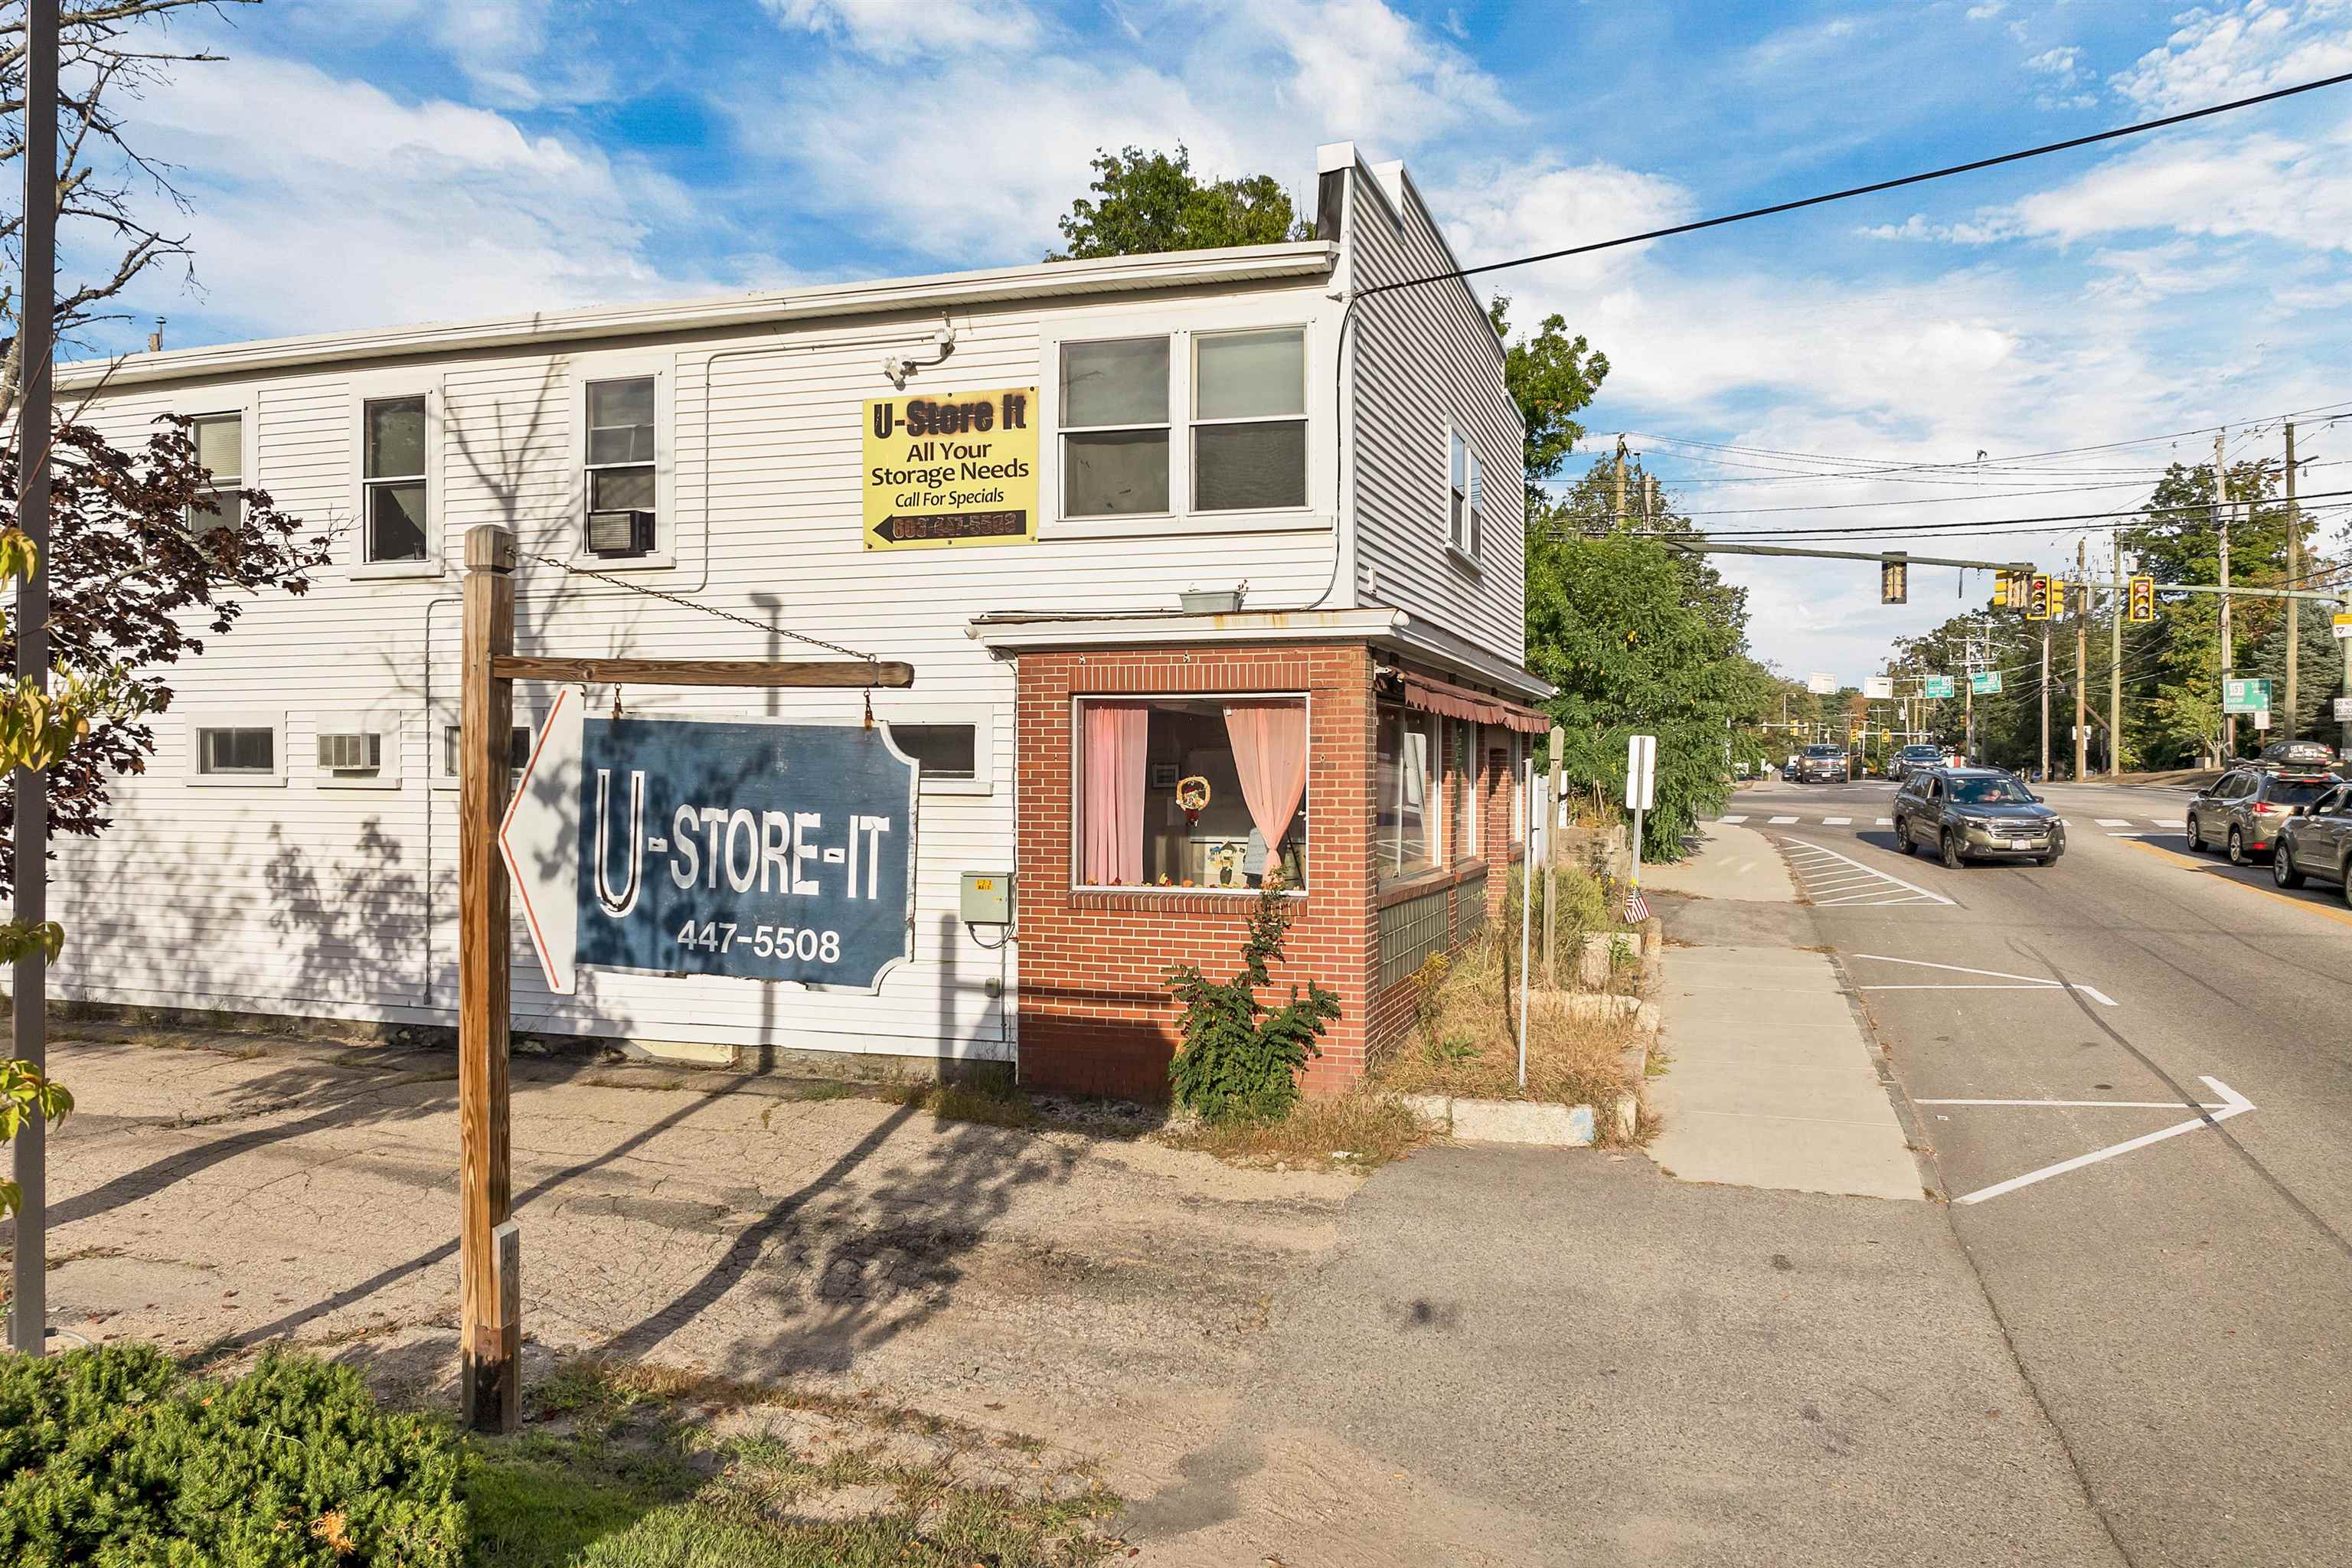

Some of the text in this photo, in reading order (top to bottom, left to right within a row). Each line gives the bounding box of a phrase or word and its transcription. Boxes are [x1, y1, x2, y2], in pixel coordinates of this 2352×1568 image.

[874, 394, 1027, 439] U-Store It
[906, 442, 992, 462] All Your
[871, 458, 1029, 488] Storage Needs
[895, 488, 1004, 508] Call For Specials
[594, 768, 891, 919] U-STORE-IT
[677, 920, 841, 964] 447-5508
